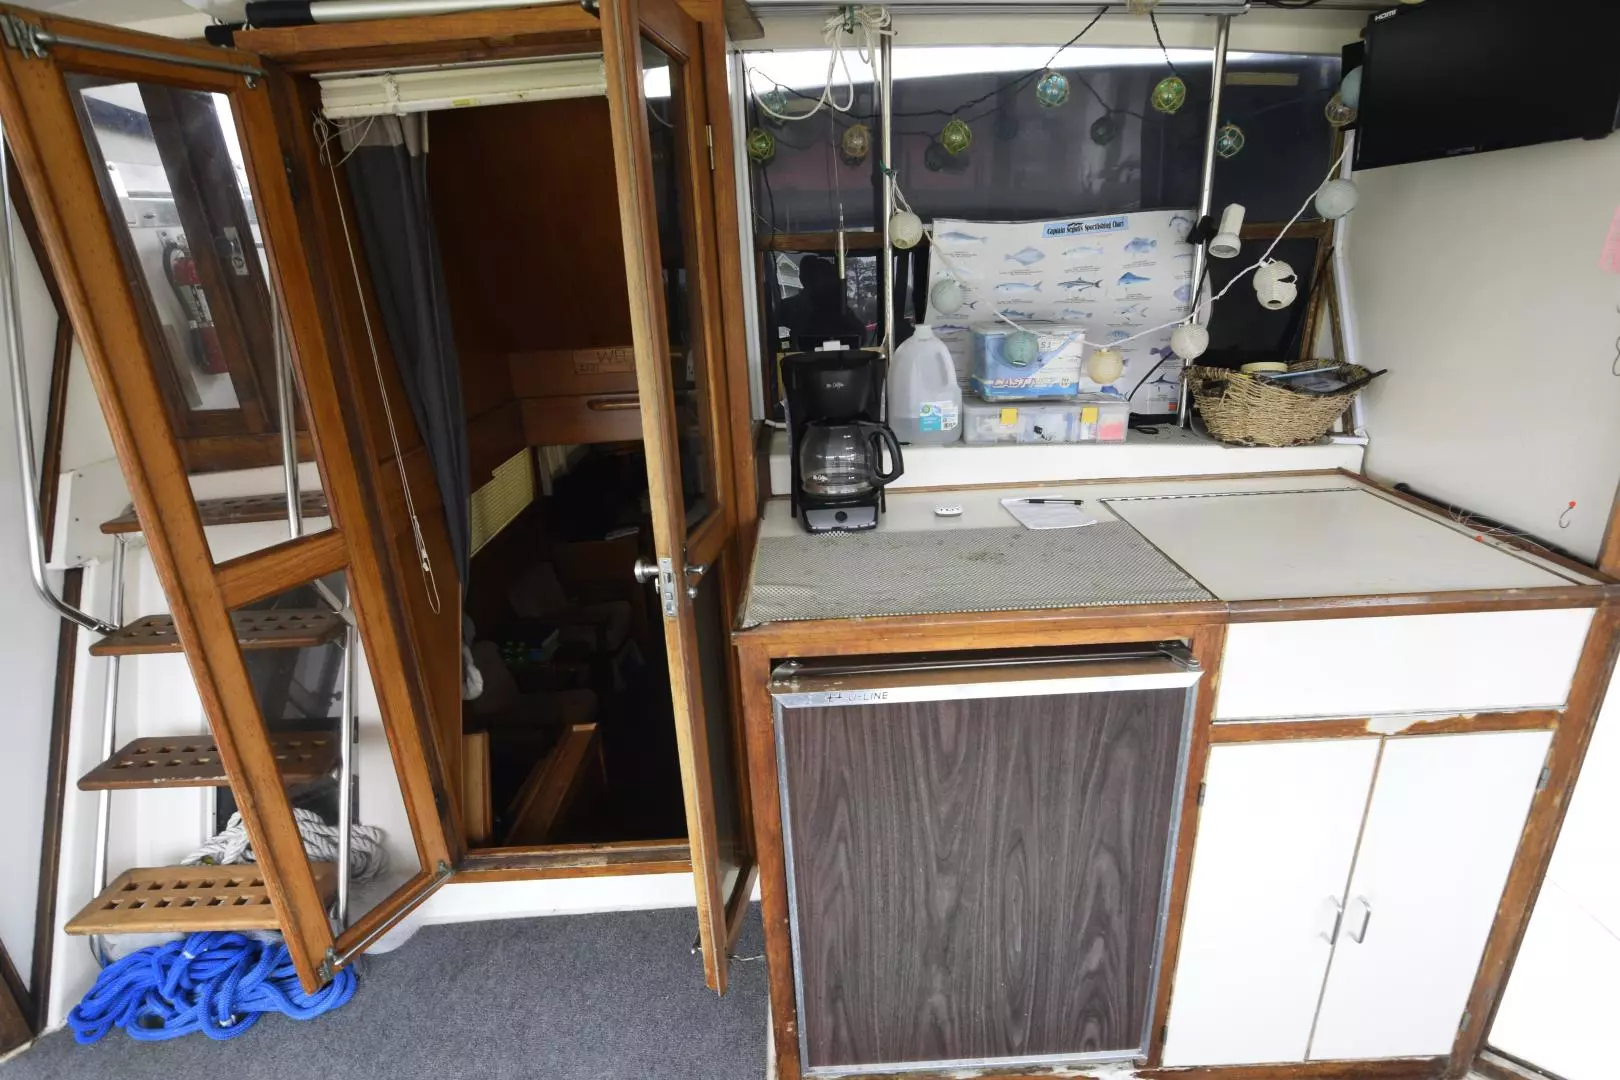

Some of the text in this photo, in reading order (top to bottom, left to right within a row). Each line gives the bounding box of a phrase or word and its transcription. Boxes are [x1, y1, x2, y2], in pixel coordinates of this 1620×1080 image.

[1374, 9, 1397, 21] HDMI
[1047, 226, 1066, 235] Captain
[1112, 220, 1124, 228] Chart
